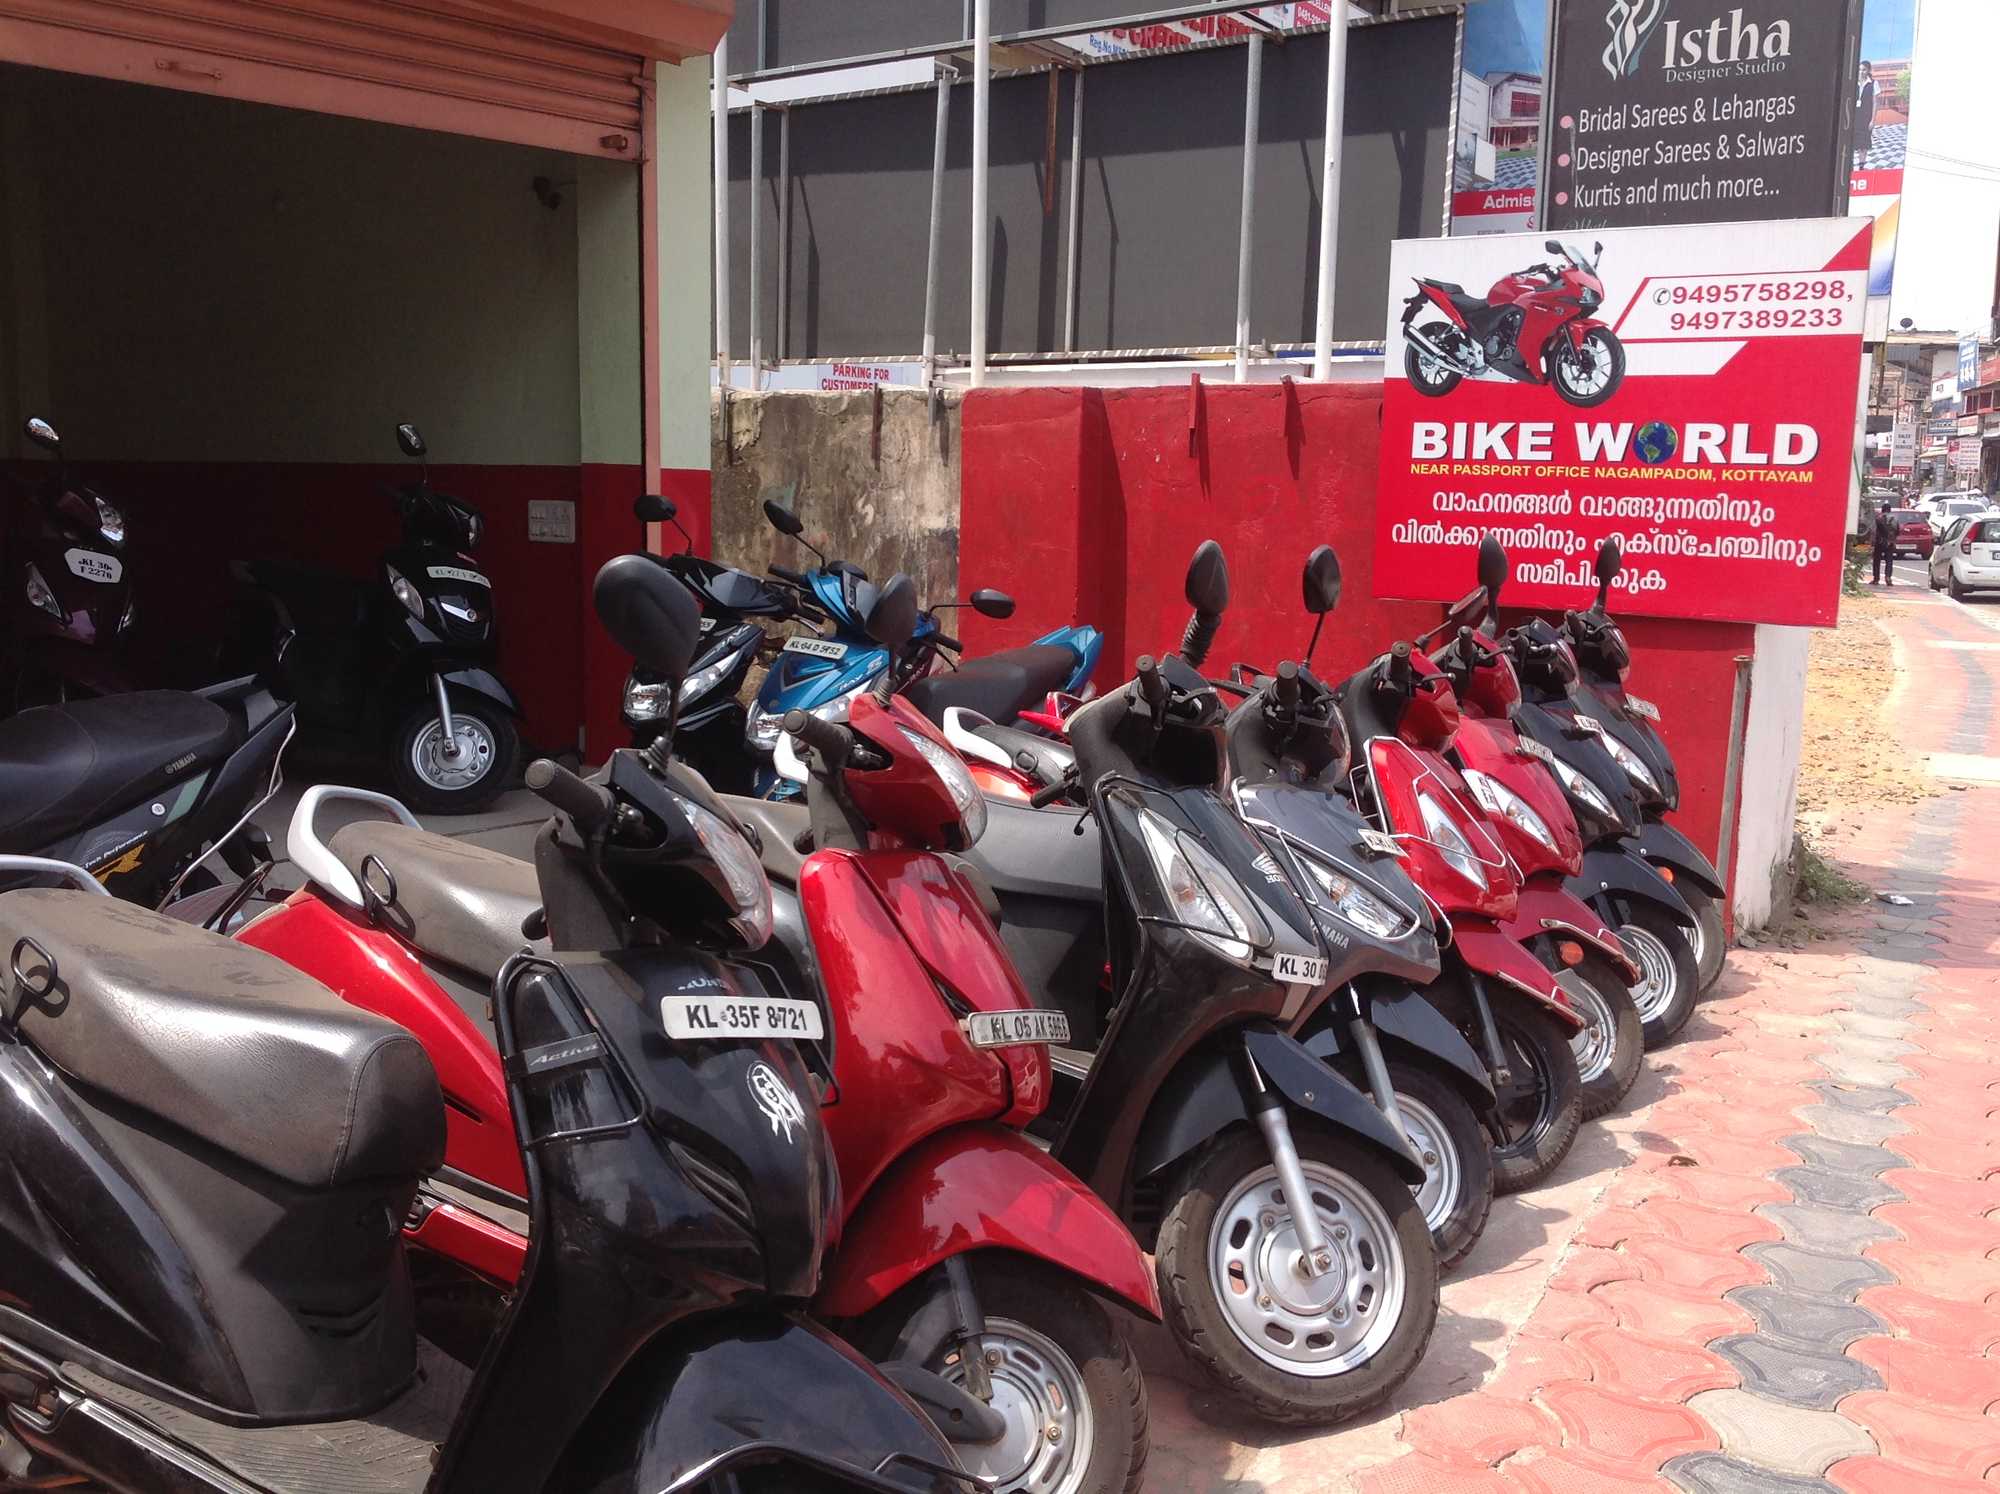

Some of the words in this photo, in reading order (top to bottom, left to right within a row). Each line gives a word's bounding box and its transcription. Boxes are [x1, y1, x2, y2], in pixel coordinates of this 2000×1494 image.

[1662, 8, 1791, 69] Istha
[1665, 66, 1732, 83] Designer
[1735, 59, 1786, 76] Studio
[1579, 104, 1627, 133] Bridal
[1631, 104, 1688, 129] Sarees
[1692, 97, 1706, 123] &
[1712, 93, 1796, 123] Lehangas
[1576, 144, 1650, 174] Designer
[1654, 140, 1711, 165] Sarees
[1716, 134, 1730, 160] &
[1735, 131, 1805, 159] Salwars
[1574, 182, 1621, 208] Kurtis
[1625, 177, 1659, 205] and
[1663, 174, 1711, 202] much
[1716, 176, 1780, 199] more...
[1670, 308, 1842, 330] 9497389233
[833, 363, 871, 379] PARKING
[875, 368, 890, 380] FOR
[1411, 422, 1555, 461] BIKE
[1410, 463, 1449, 475] NEAR
[1453, 464, 1531, 477] PASSPORT
[1535, 465, 1590, 478] OFFICE
[1595, 466, 1717, 482] NAGAMPADOM,
[1722, 469, 1813, 482] KOTTAYAM
[1279, 956, 1298, 976] KL
[1303, 960, 1317, 978] 30
[686, 1005, 718, 1029] KL
[726, 1005, 760, 1028] 35F
[767, 1006, 807, 1031] 8721
[991, 1016, 1011, 1040] KL
[1014, 1015, 1032, 1038] 05
[529, 1042, 599, 1066] Activa
